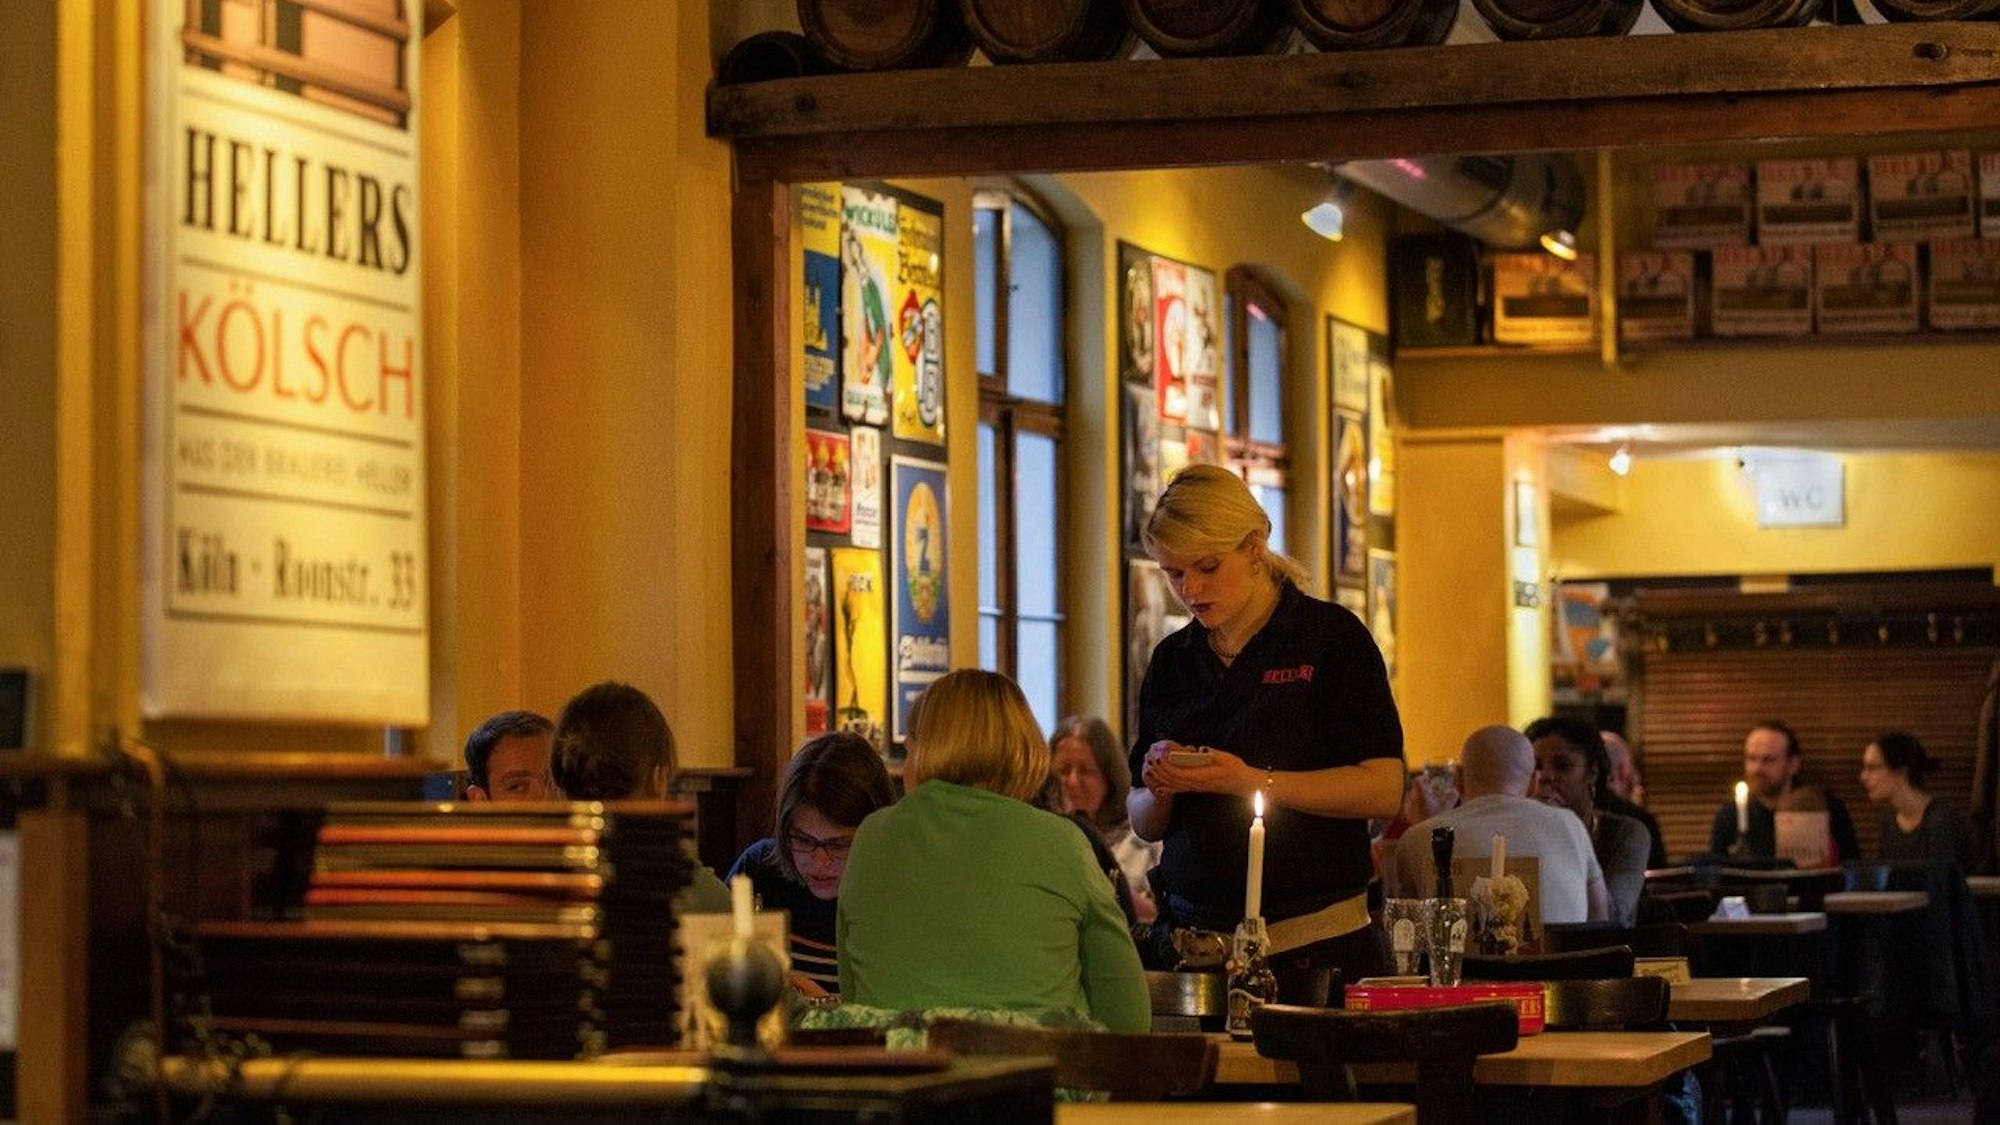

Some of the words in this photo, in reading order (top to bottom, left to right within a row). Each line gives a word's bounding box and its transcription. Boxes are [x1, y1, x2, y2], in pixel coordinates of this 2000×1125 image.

[183, 126, 410, 277] HELLERS
[177, 278, 415, 420] KÖLSCH
[1778, 484, 1826, 511] WC
[176, 526, 239, 595] Köln
[274, 536, 381, 607] Roonstr.
[388, 550, 415, 612] 33
